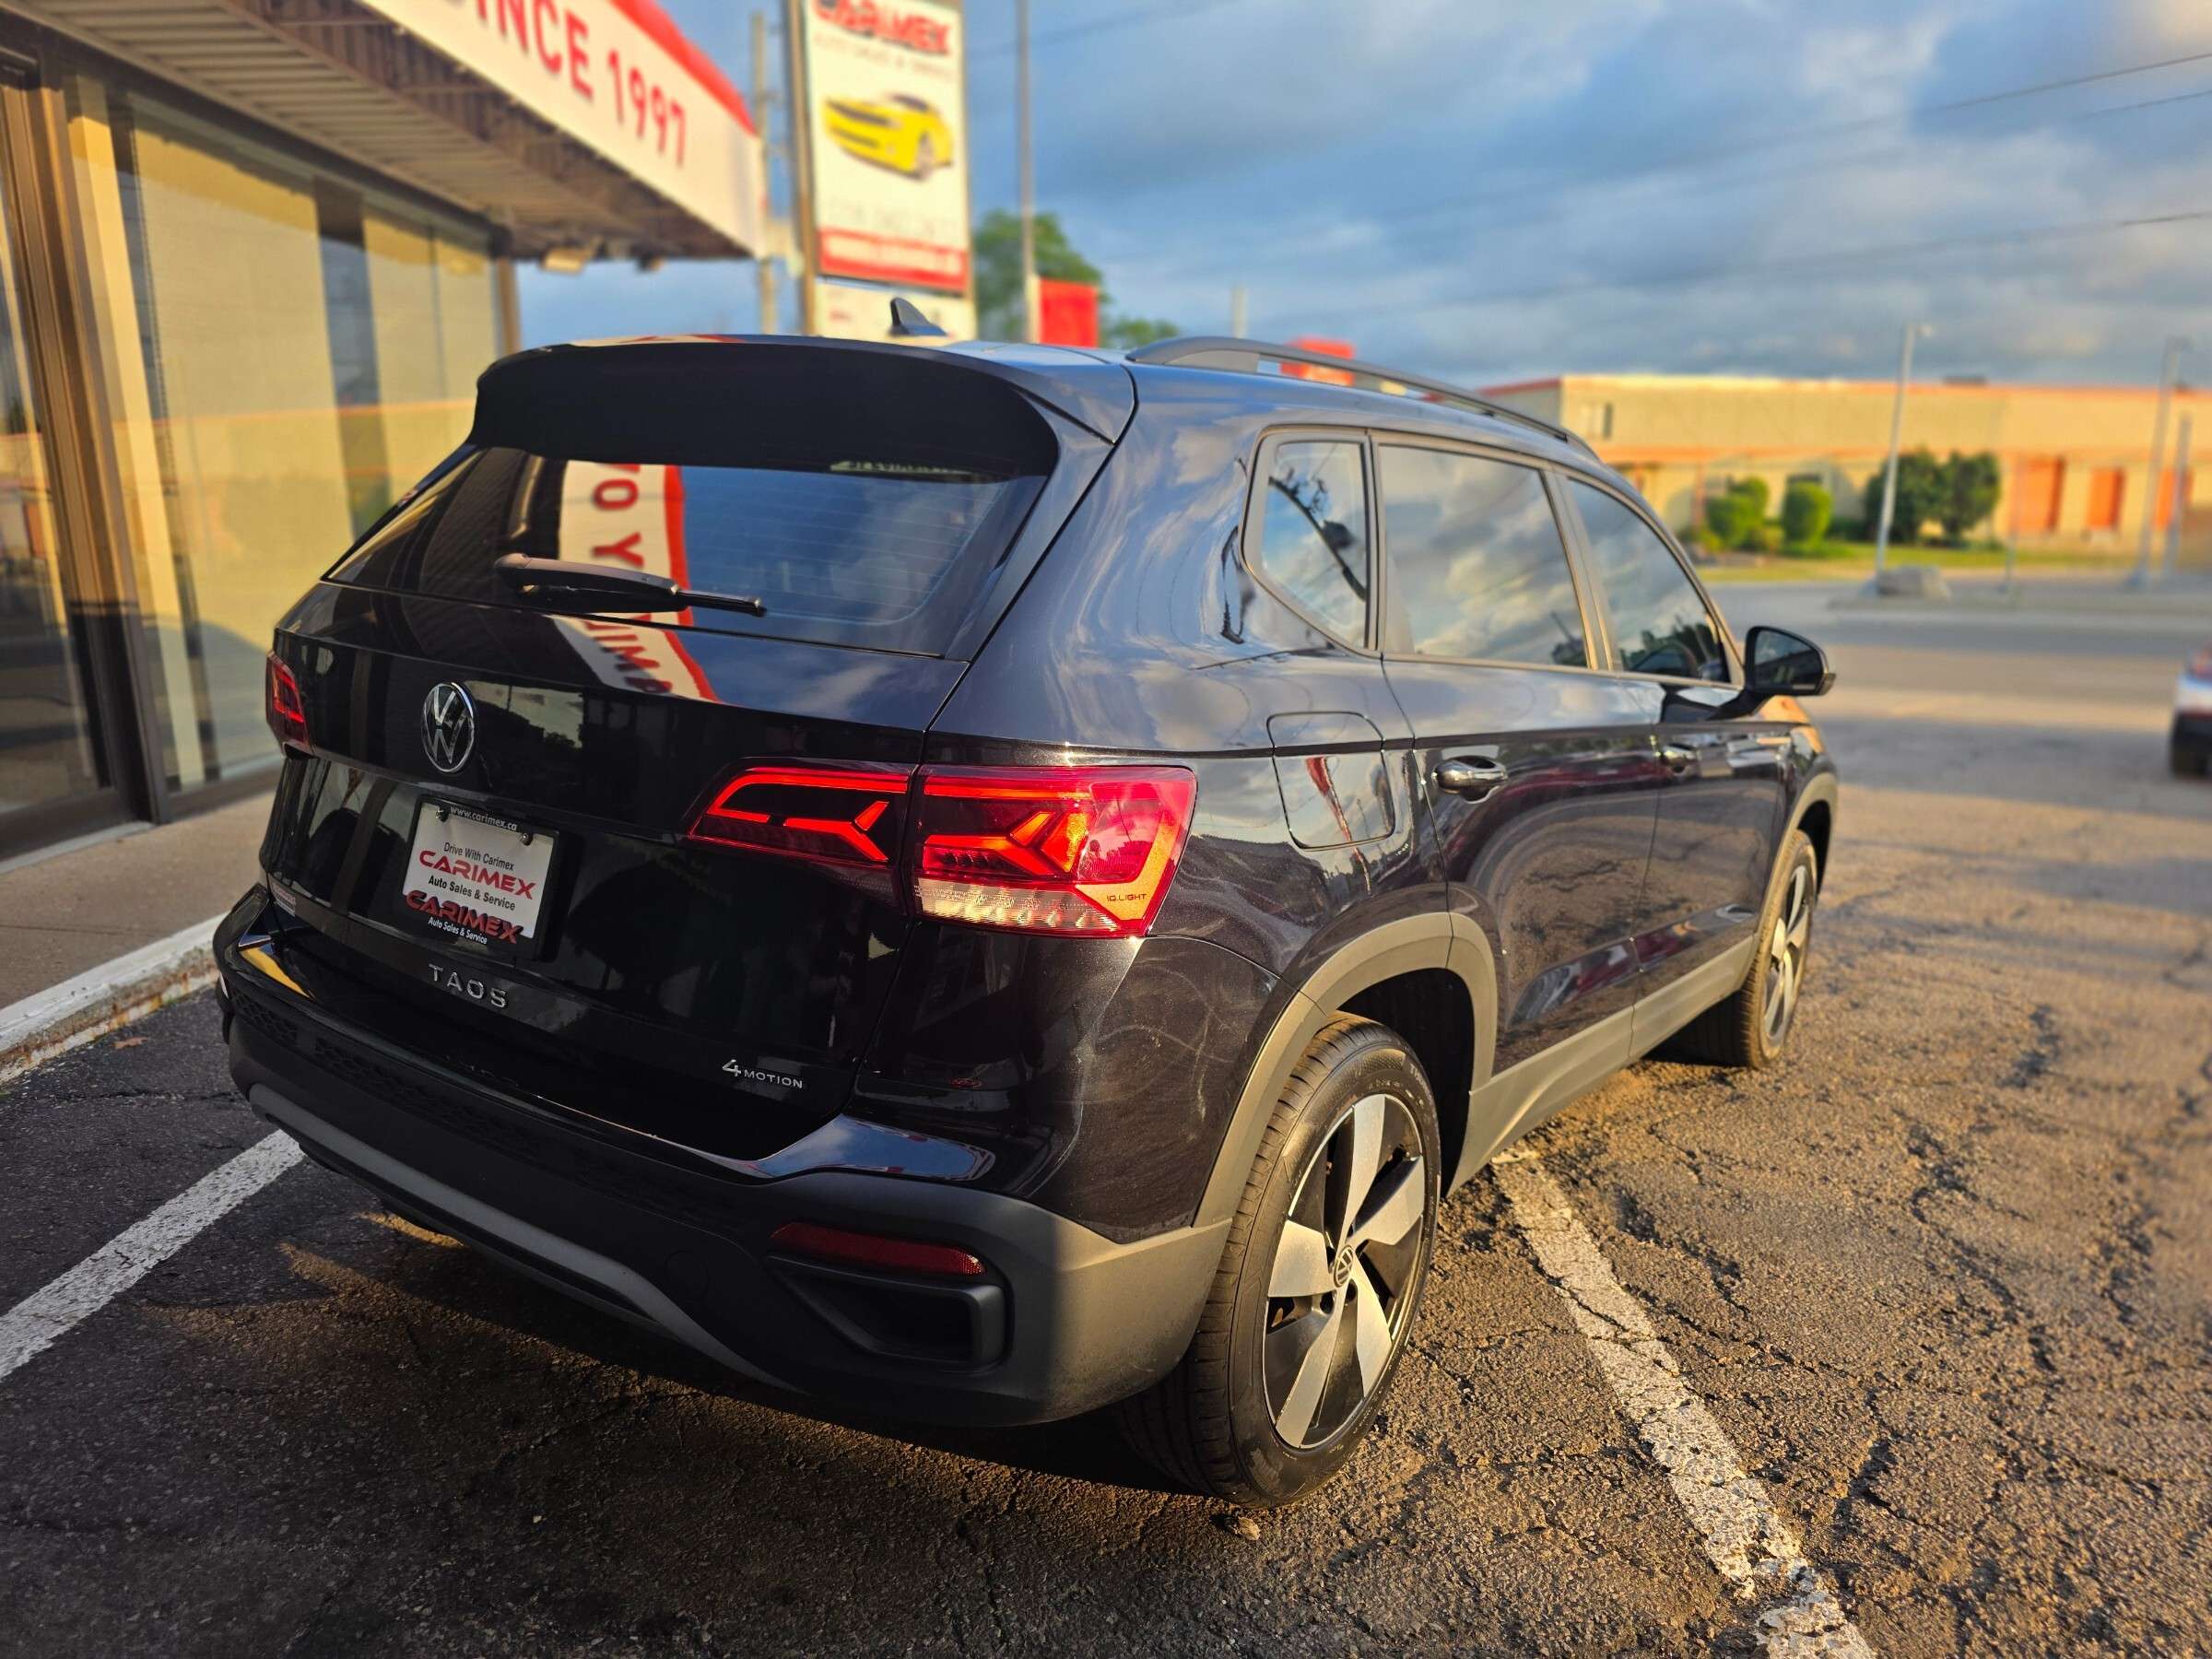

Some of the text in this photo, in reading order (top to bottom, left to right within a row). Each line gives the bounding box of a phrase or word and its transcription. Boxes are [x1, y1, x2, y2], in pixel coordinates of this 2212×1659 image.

[608, 49, 687, 168] 1997
[450, 805, 517, 831] www.carimex.ca
[419, 850, 536, 900] CARIMEX
[443, 841, 515, 871] Drive With Carimex
[429, 875, 516, 912] Auto Sales & Service
[406, 889, 524, 945] CARIMEX
[428, 916, 488, 945] Auto Sales & Service
[429, 963, 508, 1008] TAOS
